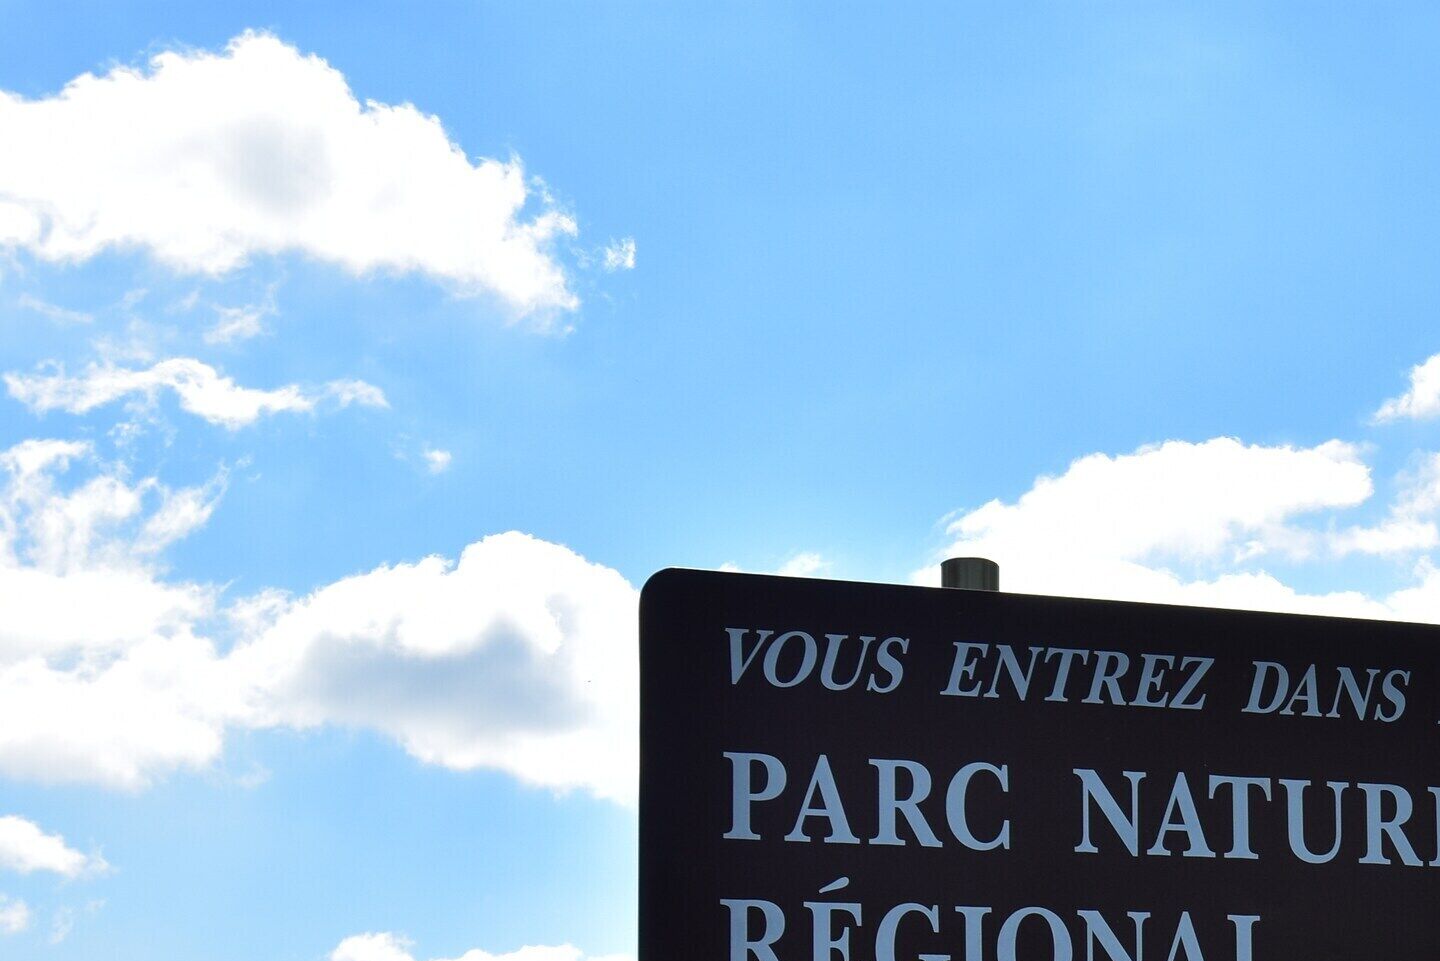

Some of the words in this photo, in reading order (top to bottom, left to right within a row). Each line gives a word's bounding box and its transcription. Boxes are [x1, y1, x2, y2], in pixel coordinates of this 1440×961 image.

[725, 627, 910, 694] VOUS
[939, 641, 1215, 710] ENTREZ
[1241, 661, 1411, 723] DANS
[723, 751, 1012, 851] PARC
